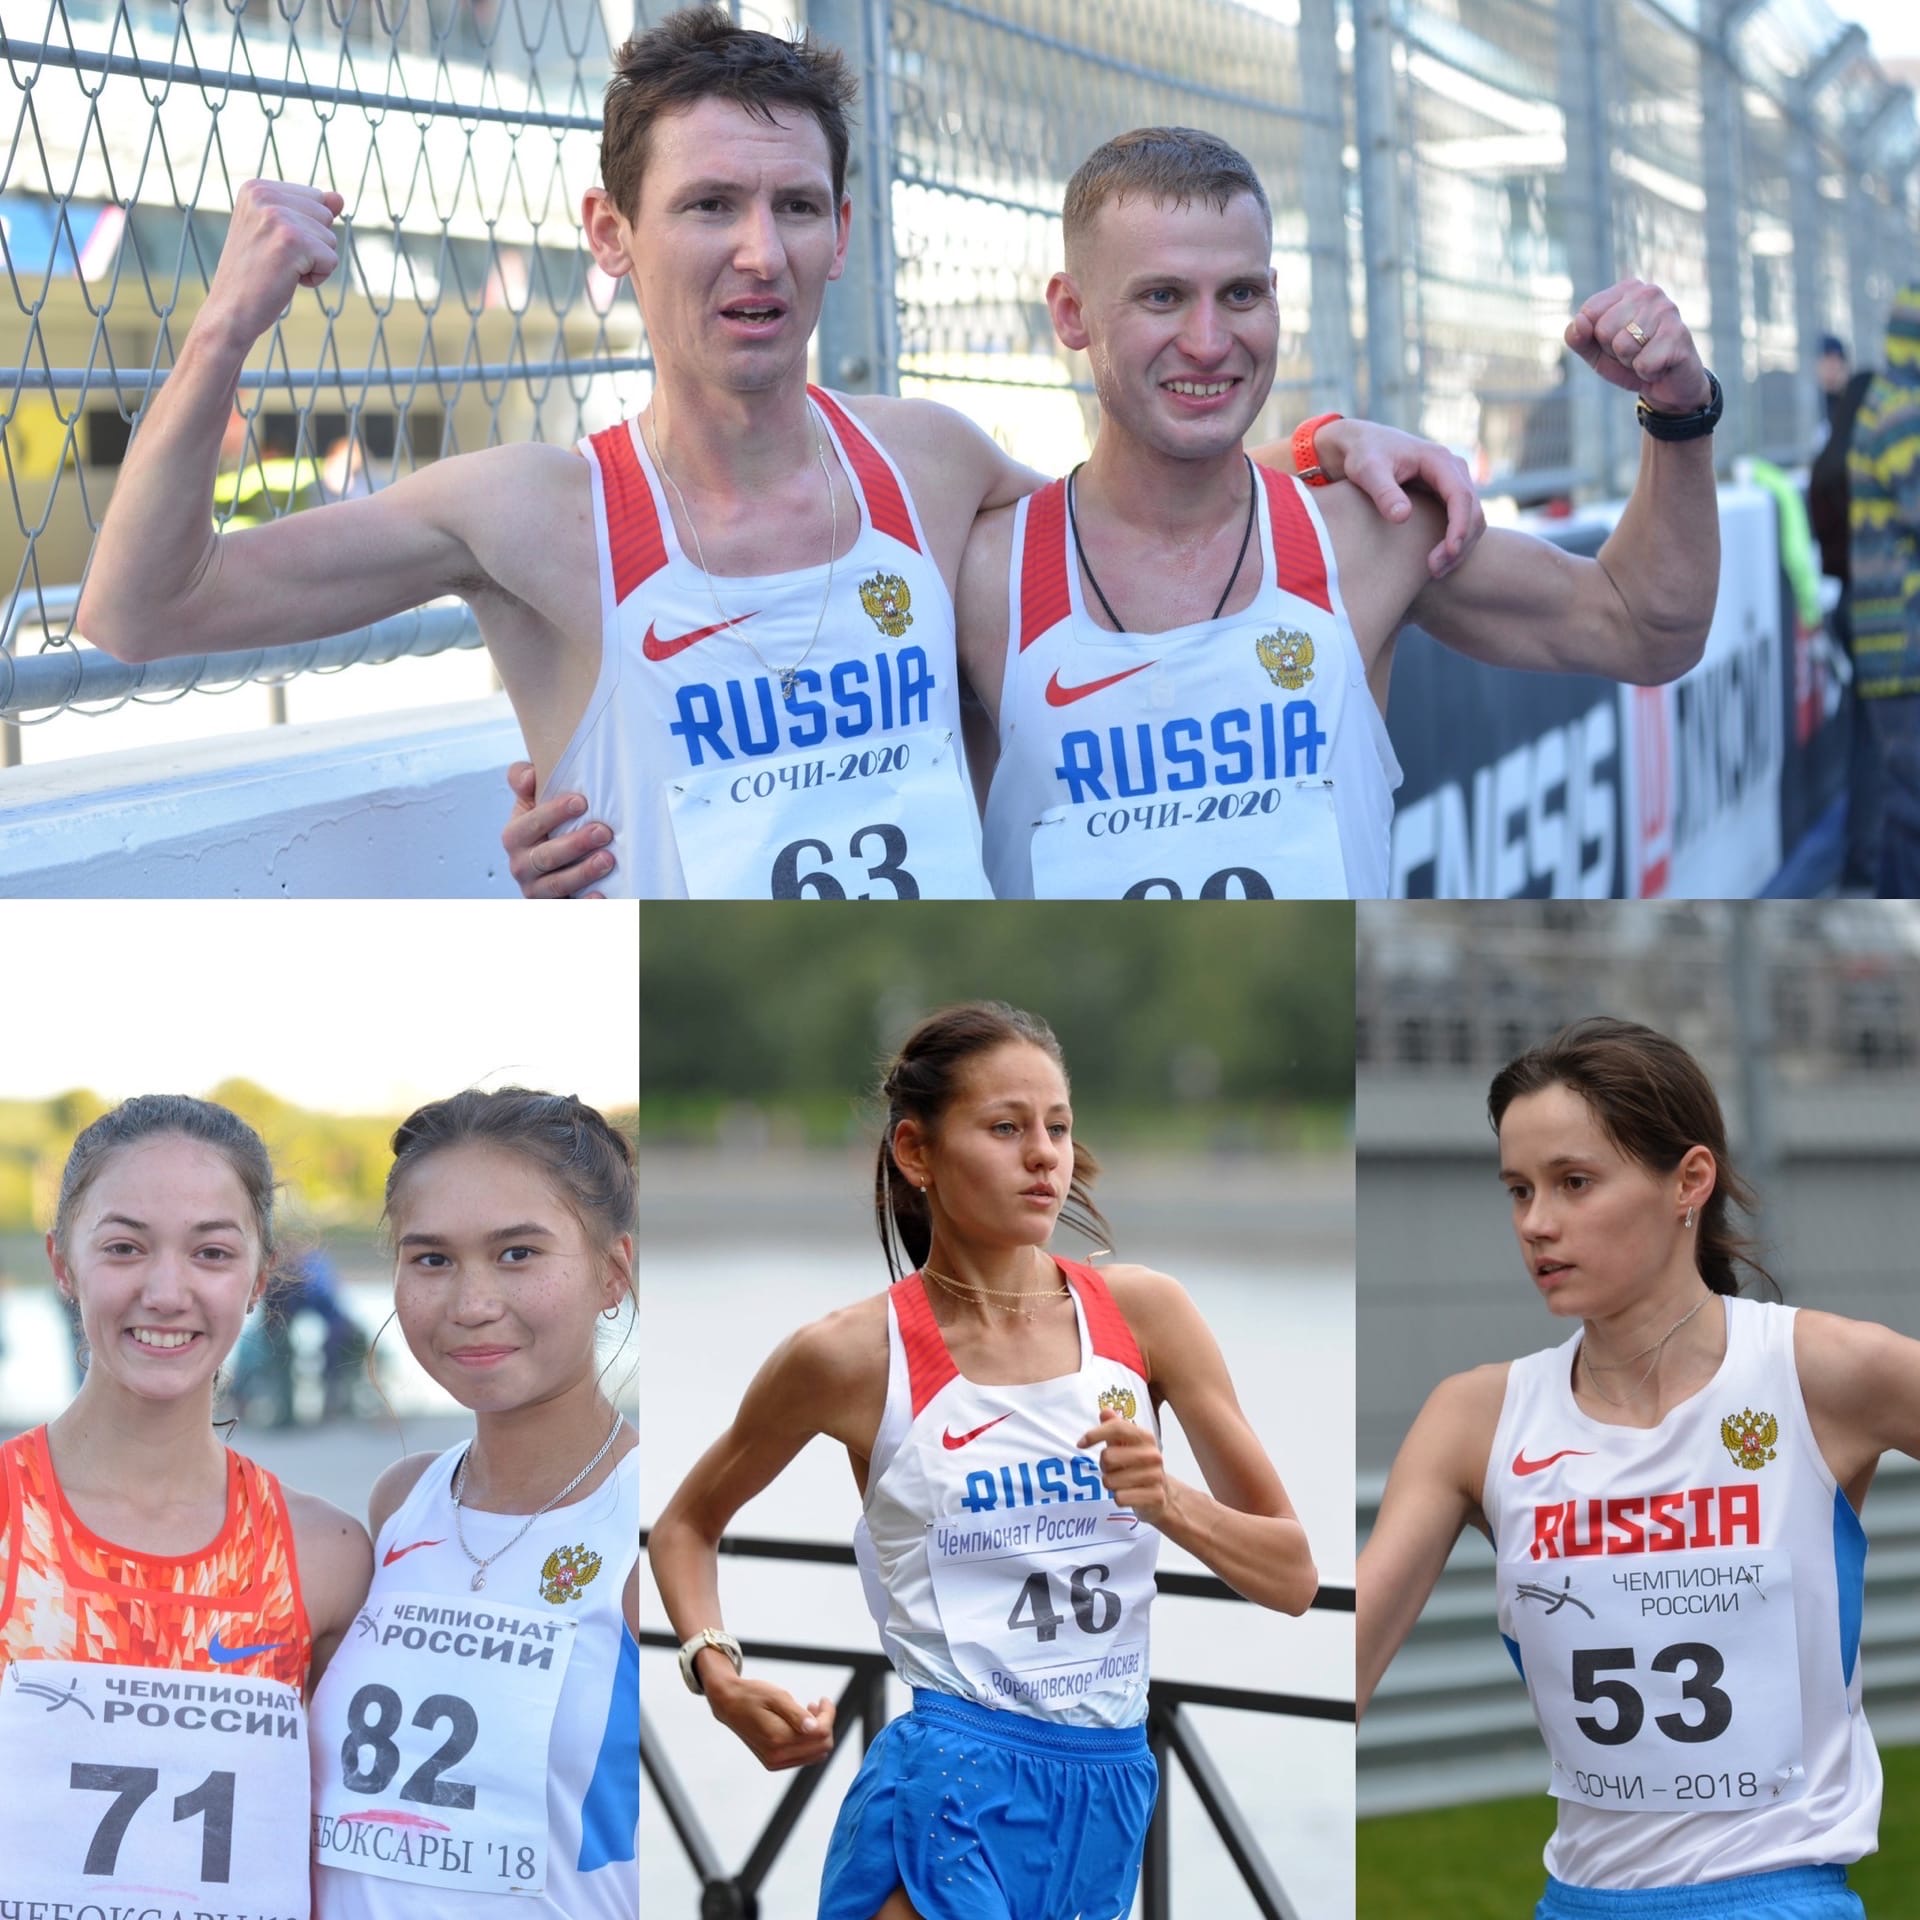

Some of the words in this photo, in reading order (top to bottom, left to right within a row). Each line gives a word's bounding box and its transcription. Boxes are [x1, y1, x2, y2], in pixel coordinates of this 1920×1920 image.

[670, 645, 936, 767] RUSSIA
[730, 744, 910, 803] СОЧИ-2020
[1055, 699, 1327, 804] RUSSIA
[1086, 788, 1281, 837] СОЧИ-2020
[771, 823, 921, 900] 63
[961, 1455, 1115, 1514] RUSS
[937, 1523, 1031, 1557] Чемпионат
[1035, 1515, 1098, 1544] России
[1529, 1483, 1760, 1562] RUSSIA
[1007, 1563, 1122, 1643] 46
[1612, 1564, 1765, 1593] ЧЕМПИОНАТ
[1641, 1592, 1740, 1617] РОССИИ
[381, 1624, 555, 1671] РОССИИ
[393, 1604, 562, 1642] ЧЕМПИОНАТ
[103, 1699, 298, 1740] РОССИИ
[105, 1677, 297, 1712] ЧЕМПИОНАТ
[1571, 1642, 1734, 1747] 53
[341, 1683, 480, 1811] 82
[1575, 1769, 1645, 1801] СОЧИ
[1674, 1771, 1758, 1800] 2018
[70, 1762, 237, 1884] 71
[311, 1813, 474, 1875] ЕБОКСАРЫ
